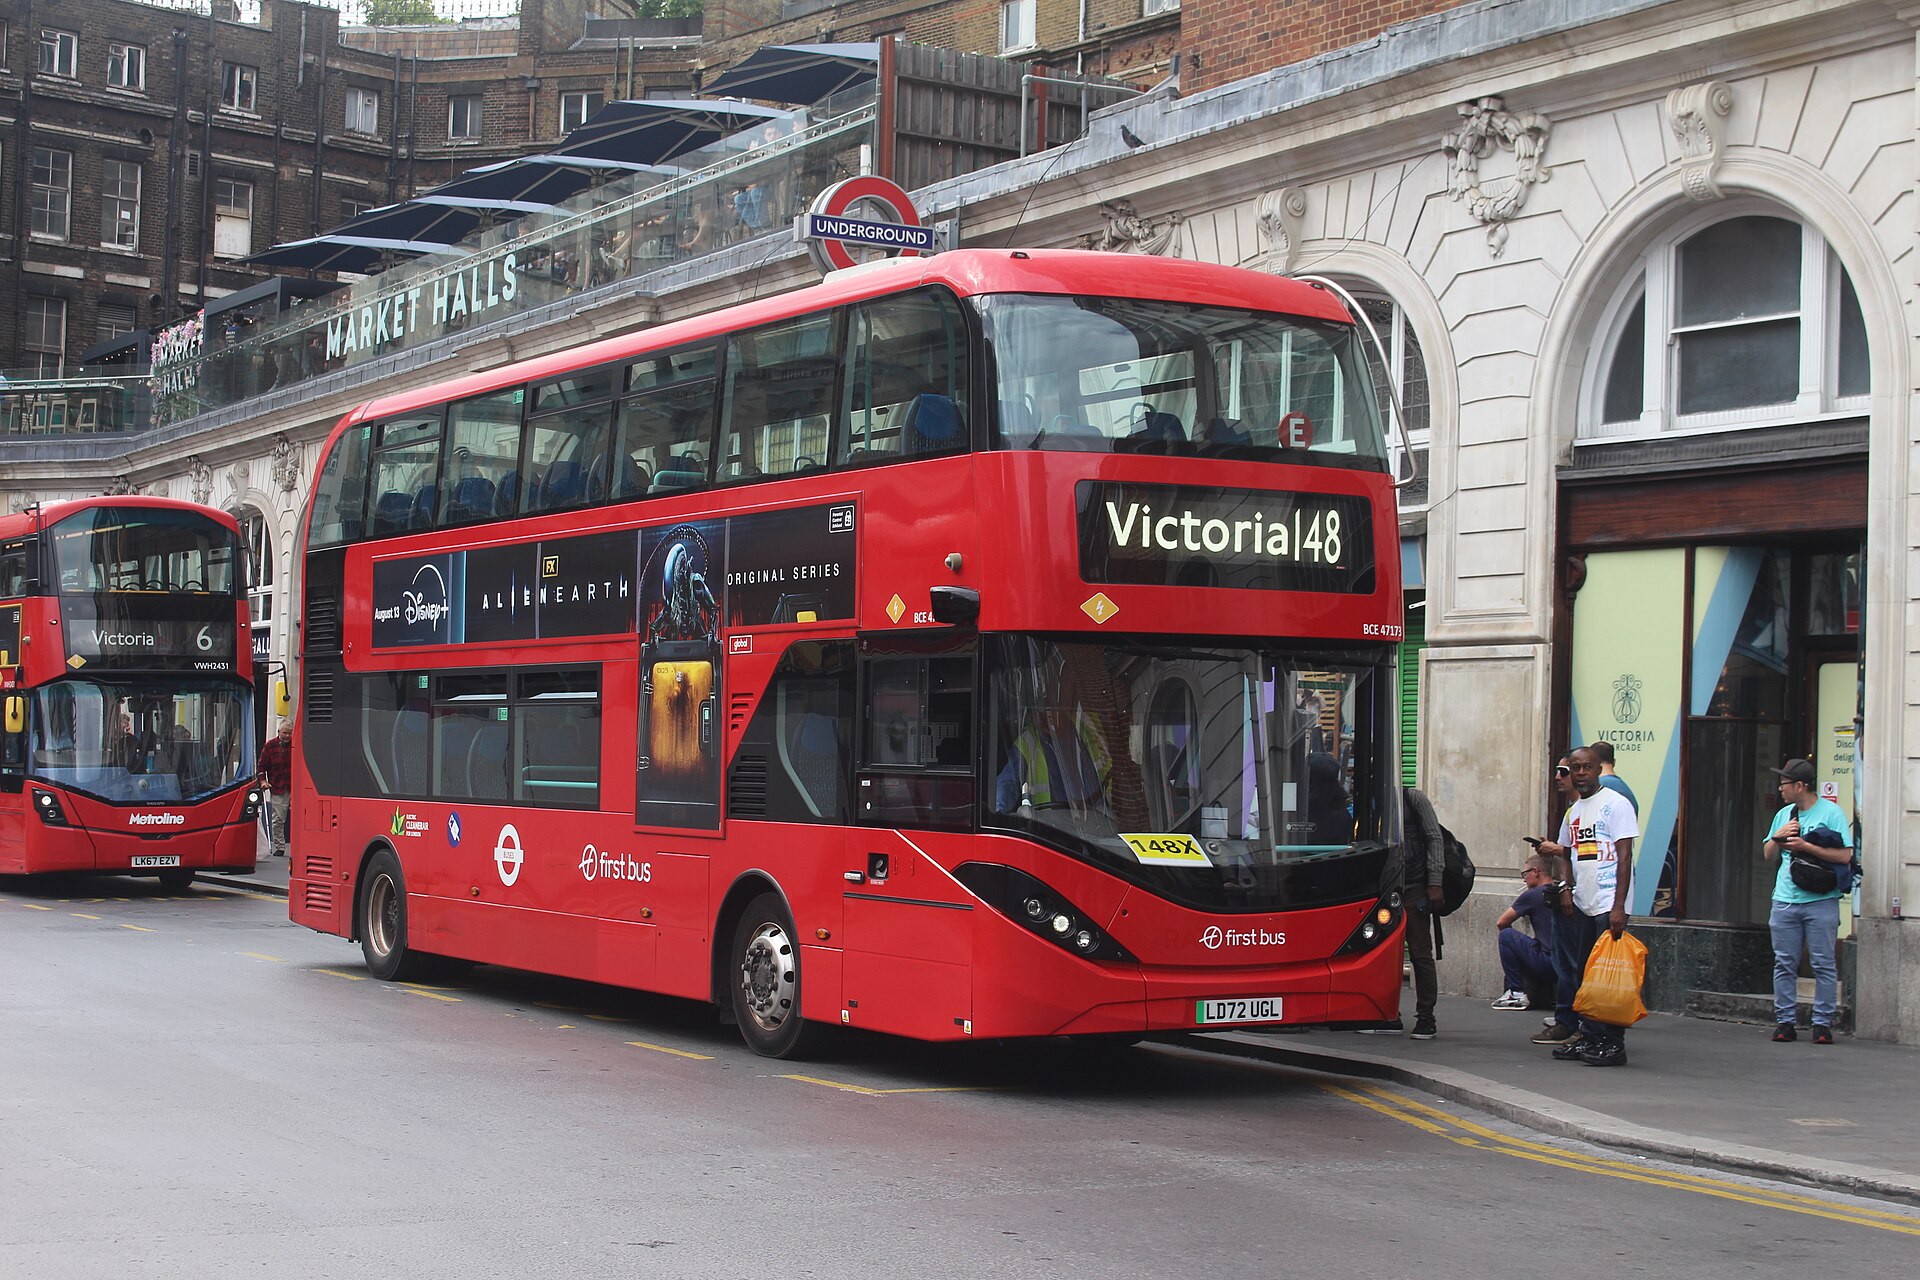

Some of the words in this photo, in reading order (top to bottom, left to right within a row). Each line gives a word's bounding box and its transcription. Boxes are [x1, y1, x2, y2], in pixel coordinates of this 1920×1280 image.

[816, 219, 927, 245] UNDERGROUND
[326, 287, 420, 361] MARKET
[432, 253, 517, 326] HALLS
[1289, 418, 1306, 447] E
[1105, 501, 1289, 556] Victoria
[1294, 508, 1342, 564] 148
[727, 567, 786, 587] ORIGINAL
[793, 562, 841, 580] SERIES
[556, 579, 628, 603] EARTH
[375, 607, 394, 623] August
[393, 605, 400, 619] 13
[913, 612, 927, 623] BCE
[91, 629, 155, 646] Victoria
[196, 625, 213, 651] 6
[1363, 623, 1380, 635] BCE
[1380, 624, 1403, 637] 47173
[733, 638, 748, 651] global
[194, 662, 230, 670] VWH2431
[1598, 730, 1655, 742] VICTORIA
[1832, 767, 1850, 775] your
[128, 812, 185, 825] Metroline
[502, 850, 516, 860] BUSES
[1129, 838, 1202, 856] 148X
[134, 857, 158, 865] LK67
[160, 856, 176, 864] EZV
[599, 852, 626, 880] first
[628, 853, 651, 883] bus
[1225, 928, 1257, 946] first
[1260, 928, 1286, 945] bus
[1206, 1002, 1247, 1020] LD72
[1250, 1000, 1280, 1017] UGL
